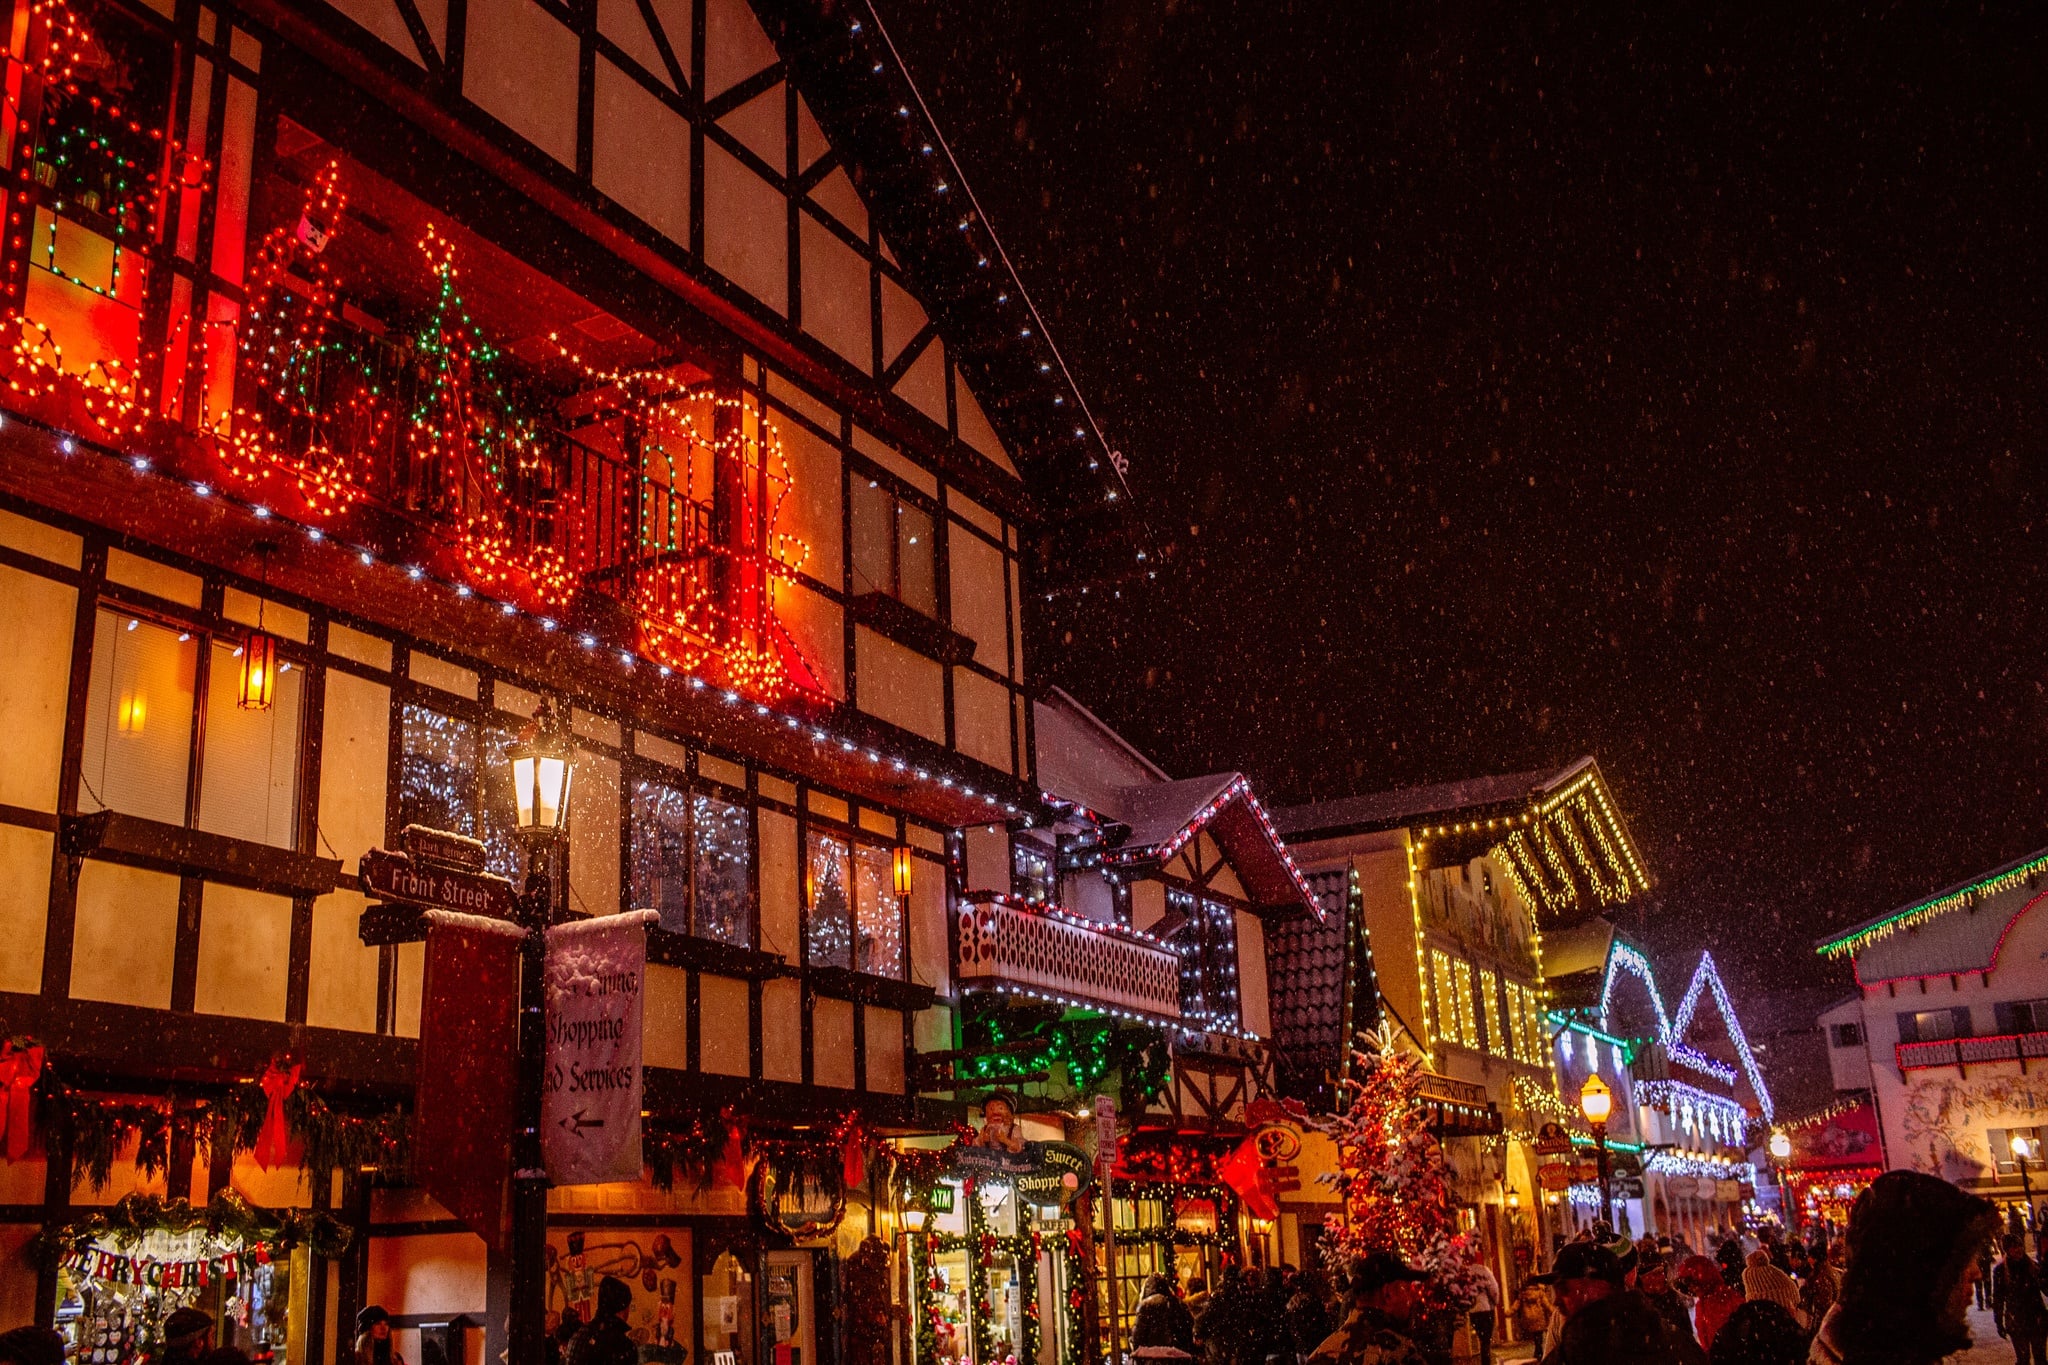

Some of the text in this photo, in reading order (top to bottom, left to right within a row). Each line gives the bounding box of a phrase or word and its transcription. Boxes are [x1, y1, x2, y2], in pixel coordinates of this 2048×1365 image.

[391, 868, 491, 909] Front Street
[549, 1012, 624, 1050] Shopping
[569, 1060, 632, 1093] Services
[1045, 1150, 1084, 1171] Sweet
[1018, 1176, 1061, 1192] Shoppe
[931, 1188, 951, 1208] ATM
